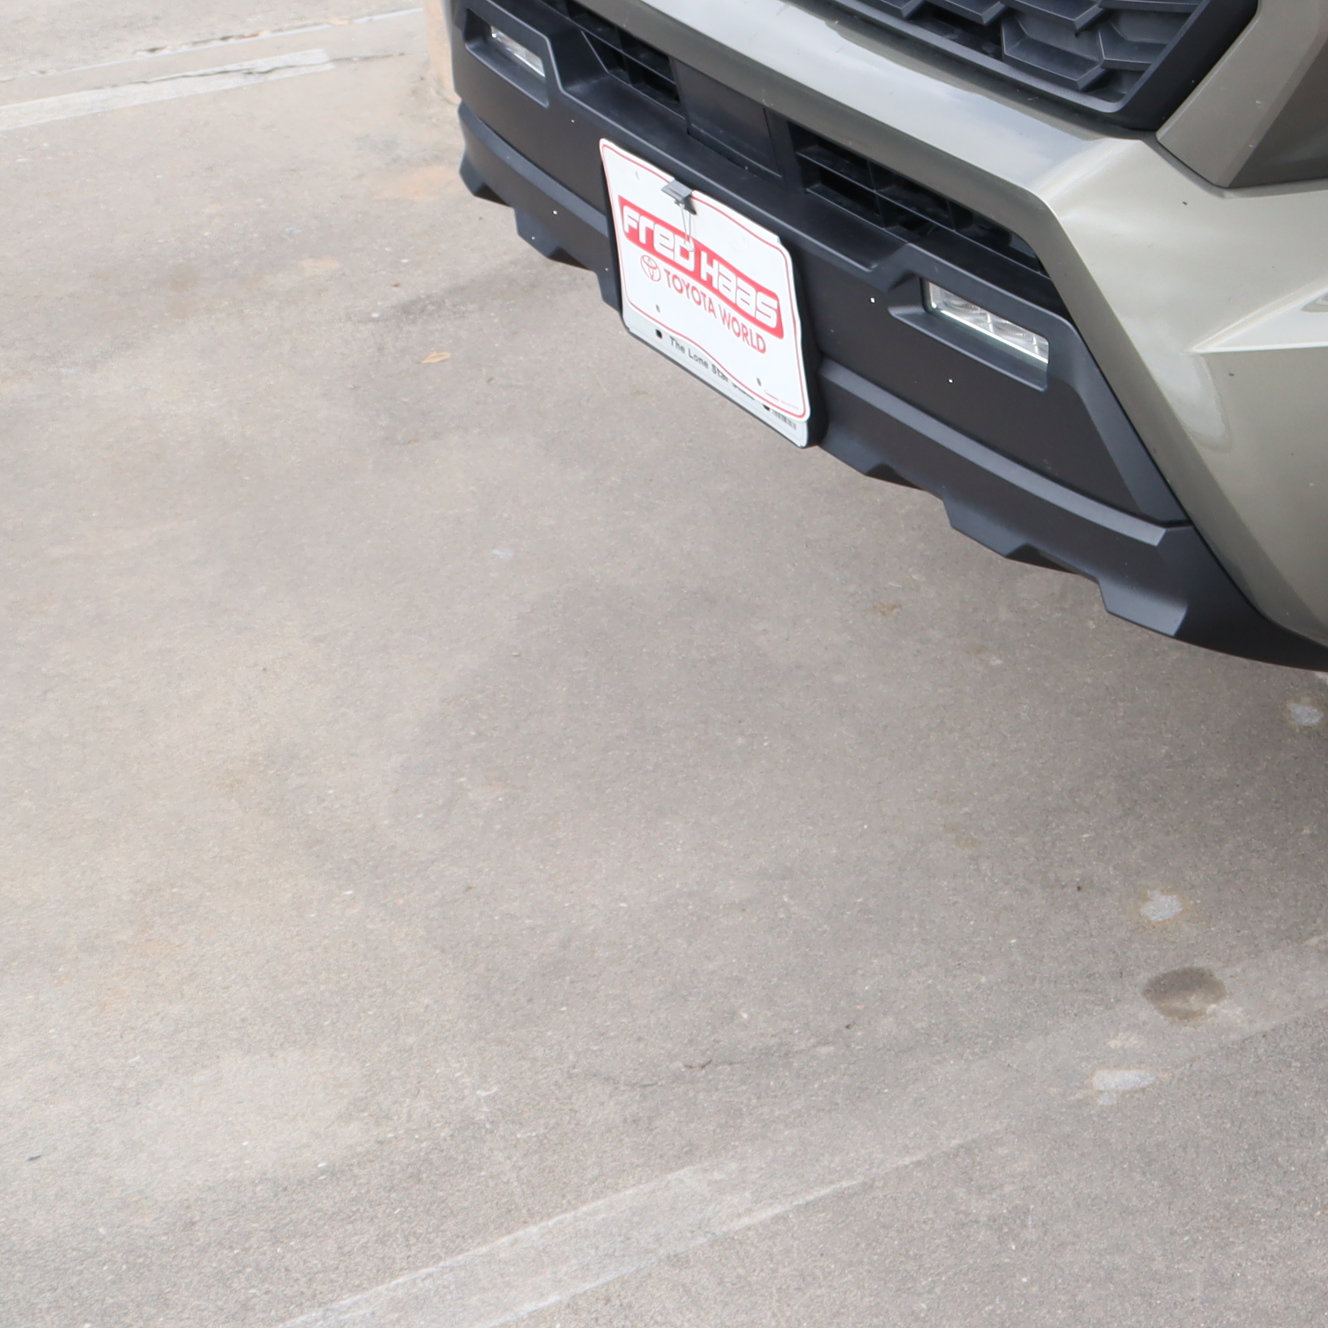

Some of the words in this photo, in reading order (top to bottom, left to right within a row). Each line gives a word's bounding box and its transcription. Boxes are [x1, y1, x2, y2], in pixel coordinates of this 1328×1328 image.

[664, 269, 717, 319] TOYOTA
[718, 304, 766, 354] WORLD
[670, 336, 685, 353] The
[688, 348, 708, 369] Lone
